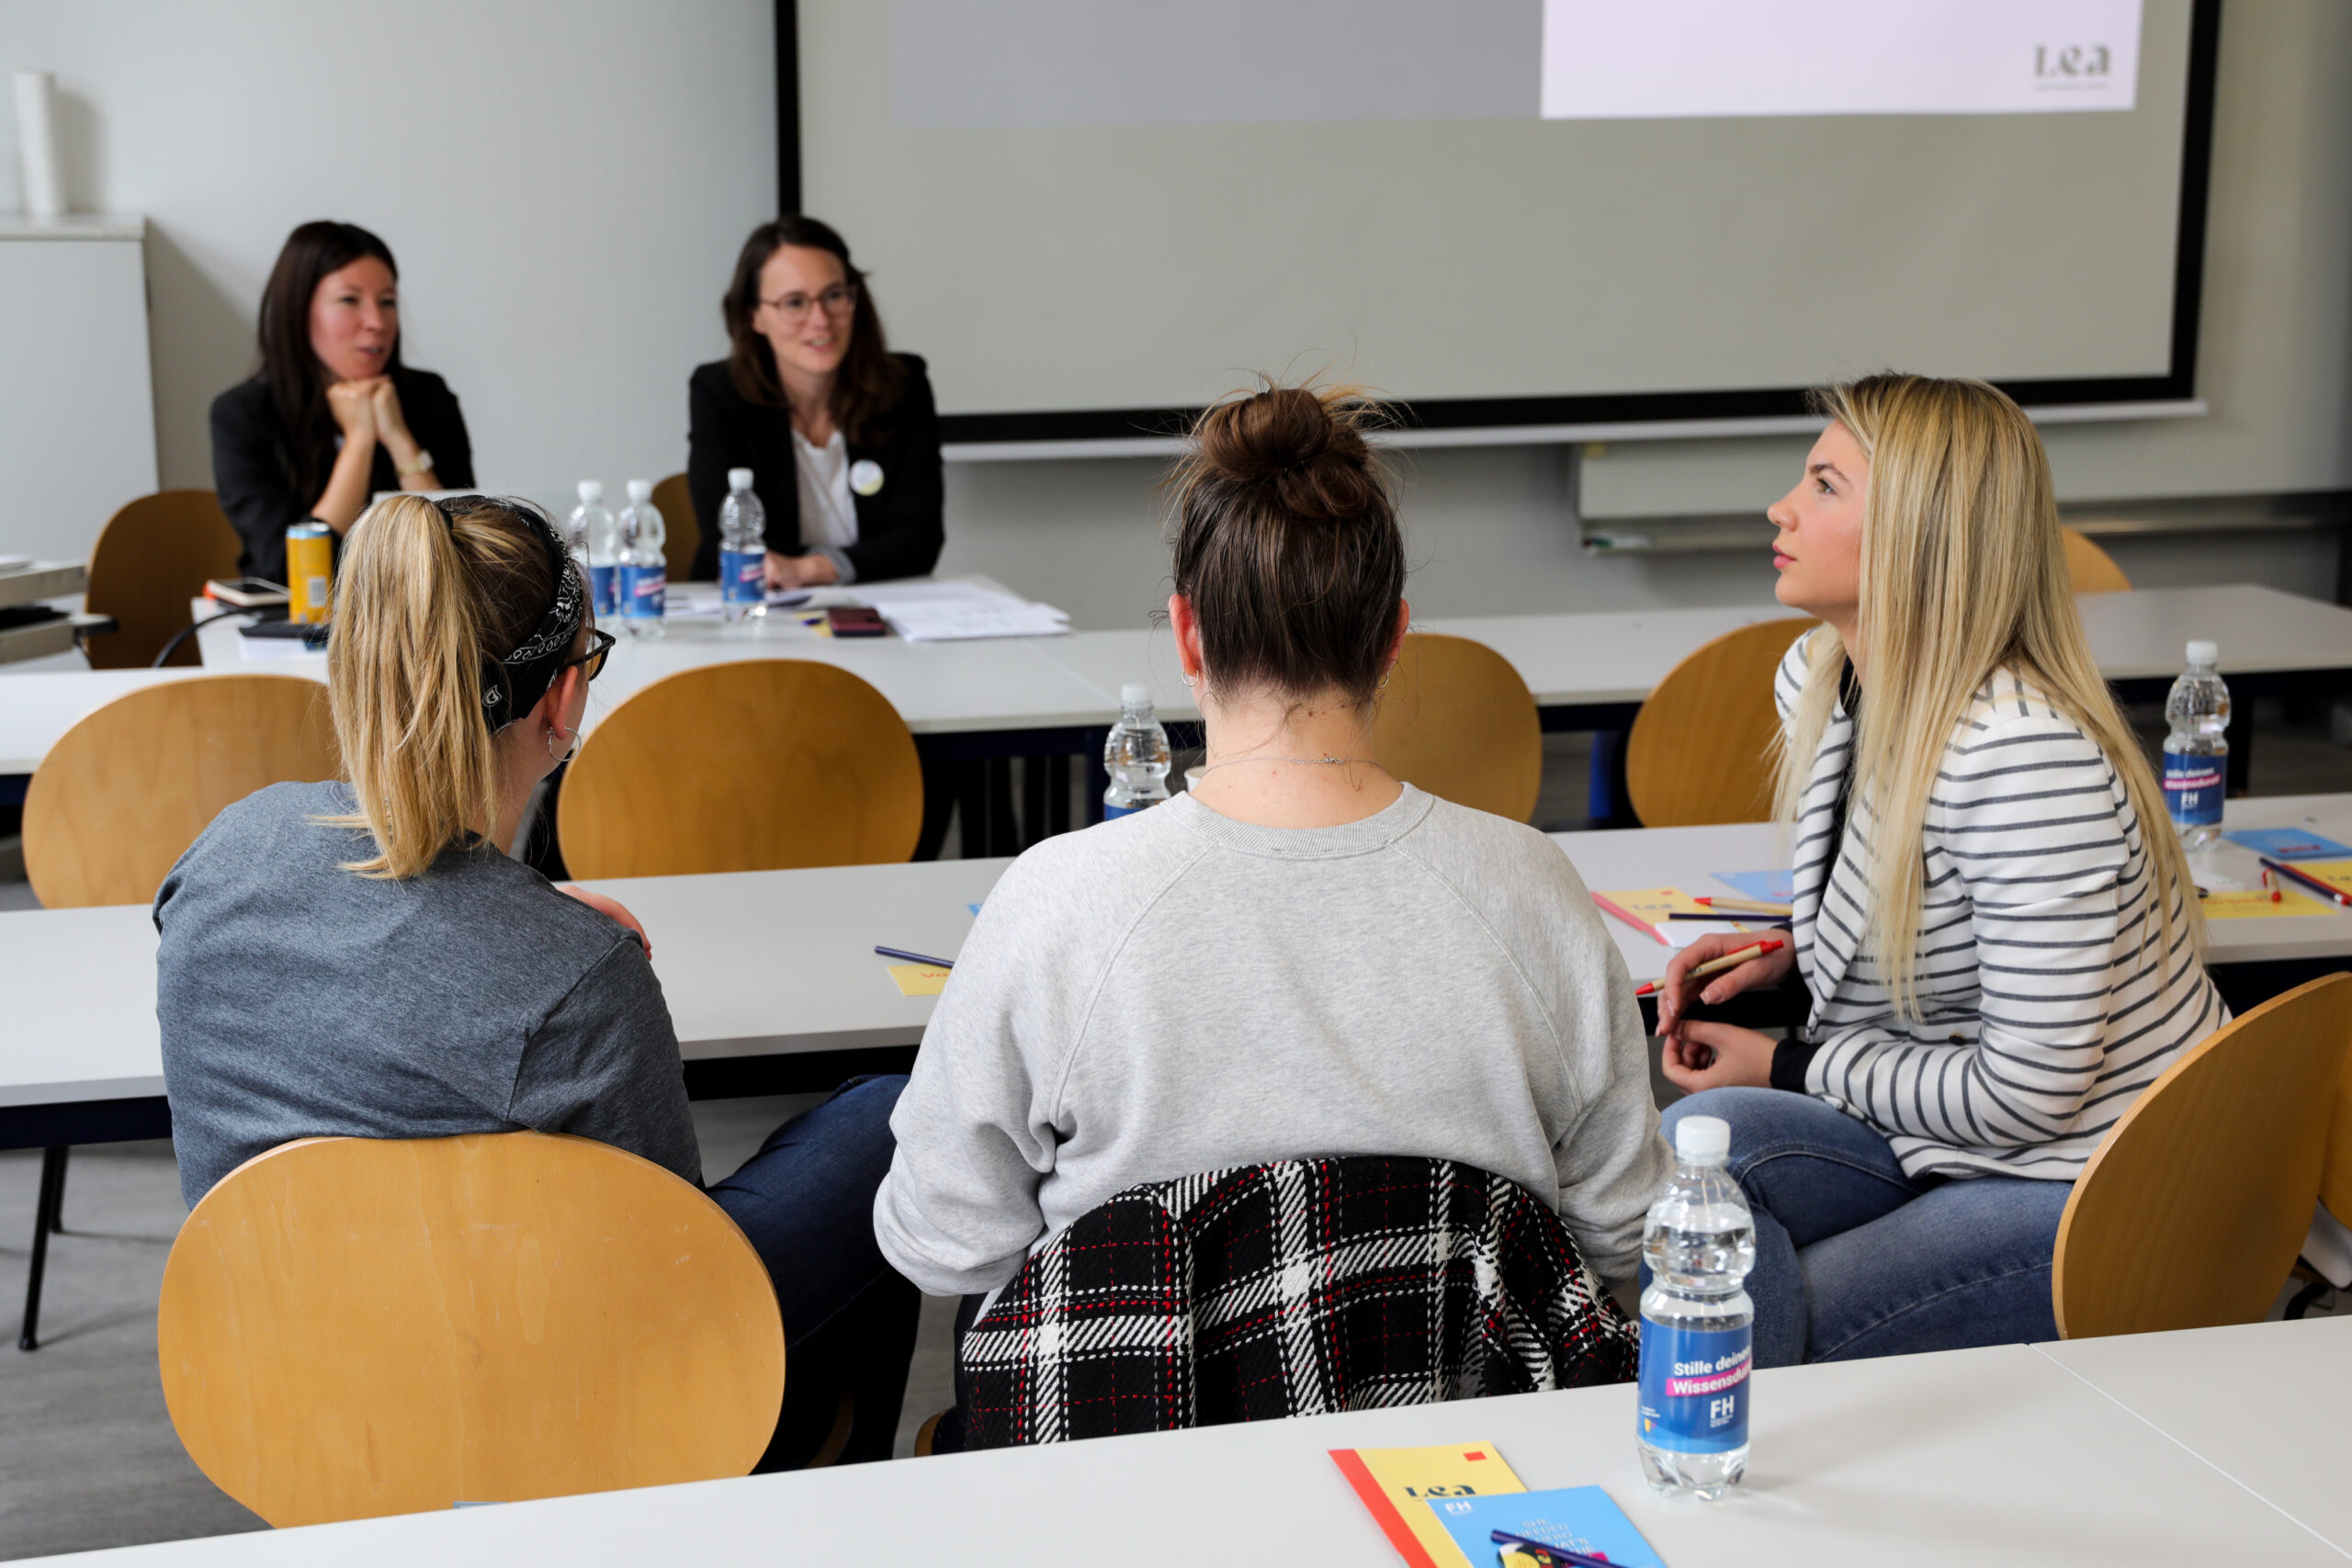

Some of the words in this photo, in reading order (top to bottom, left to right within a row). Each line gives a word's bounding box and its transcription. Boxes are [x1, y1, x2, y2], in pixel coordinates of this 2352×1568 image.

[1673, 1360, 1713, 1377] Stille
[1710, 1394, 1735, 1419] FH
[1444, 1500, 1474, 1513] FH
